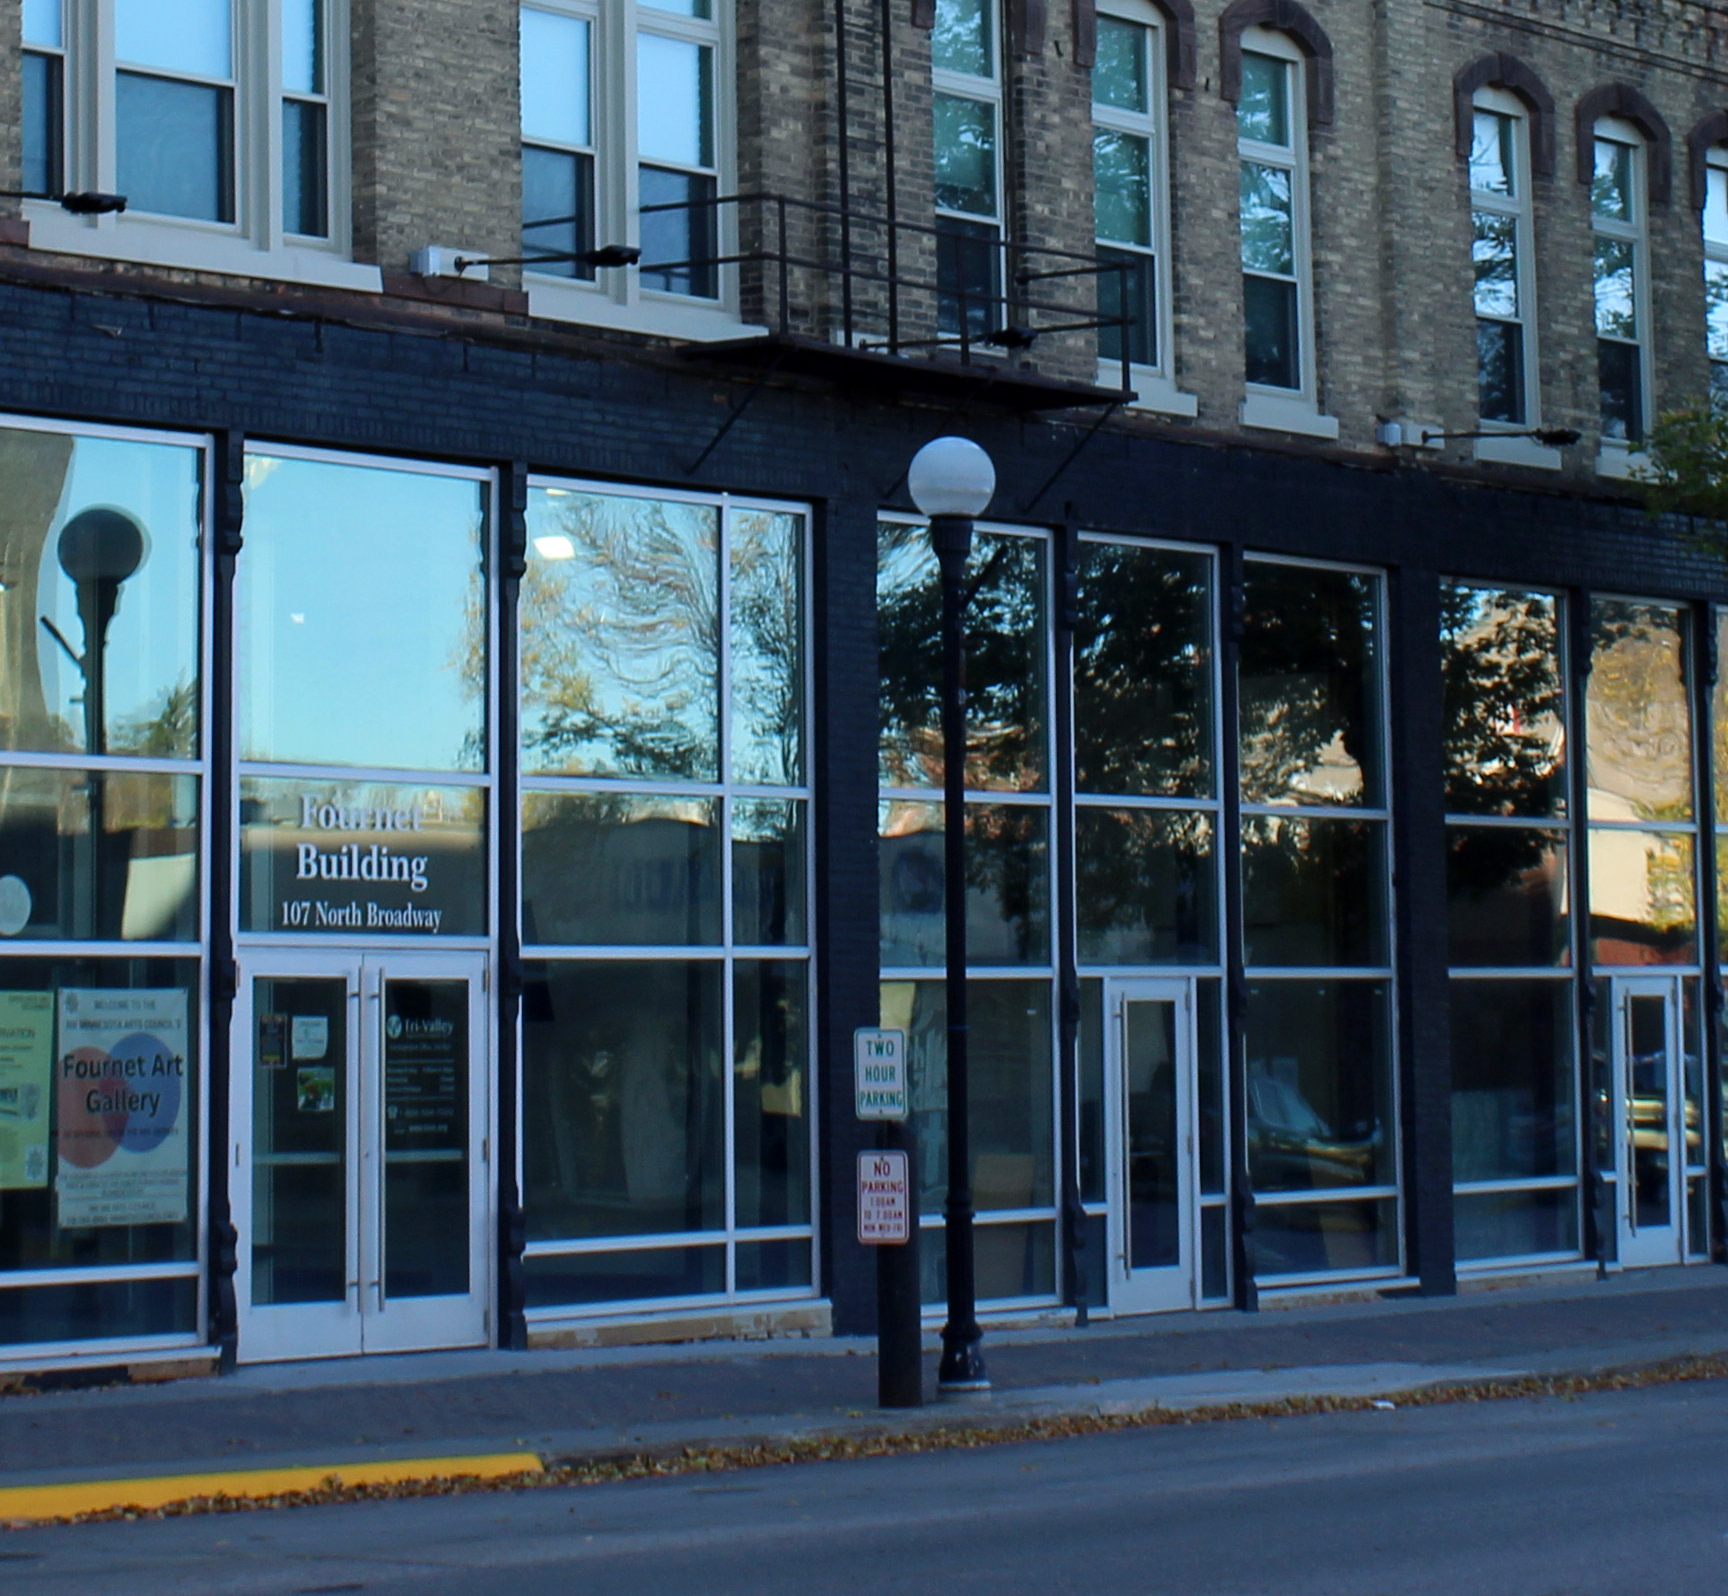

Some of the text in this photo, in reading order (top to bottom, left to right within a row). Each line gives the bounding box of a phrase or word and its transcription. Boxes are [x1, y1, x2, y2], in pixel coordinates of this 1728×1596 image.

[300, 793, 423, 832] Fournet
[296, 842, 429, 892] Building
[282, 900, 442, 934] 107 North Broadway
[405, 1017, 454, 1036] Tri-Valley
[866, 1040, 894, 1056] TWO
[63, 1052, 184, 1079] Fournet Art
[865, 1066, 896, 1081] HOUR
[86, 1089, 160, 1118] Gallery
[859, 1091, 904, 1107] PARKING
[874, 1161, 891, 1177] NO
[861, 1181, 904, 1194] PARKING
